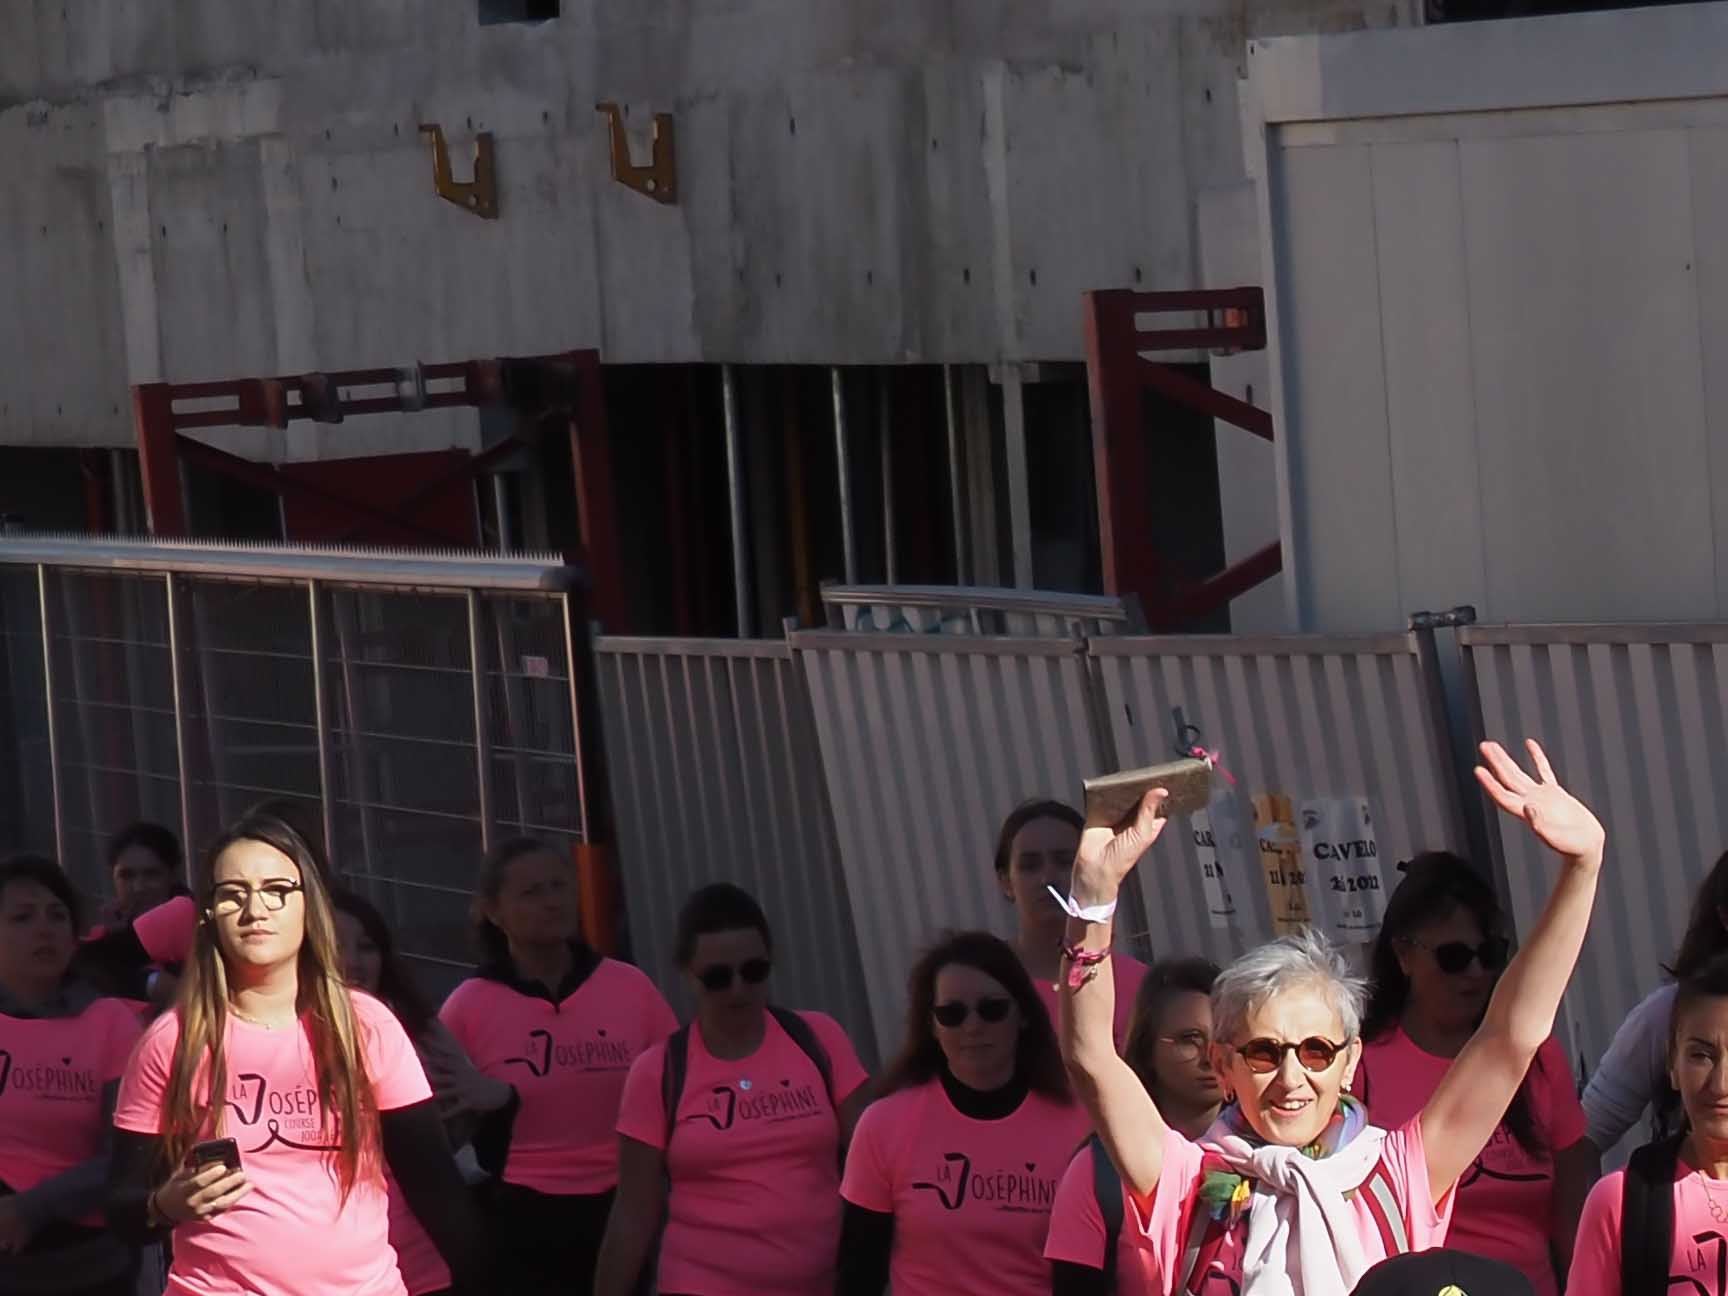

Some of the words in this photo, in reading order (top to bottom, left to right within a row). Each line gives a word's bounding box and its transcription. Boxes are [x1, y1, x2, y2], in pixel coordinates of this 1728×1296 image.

[231, 1083, 248, 1100] LA
[237, 1073, 318, 1126] JOSÉP
[936, 1164, 951, 1182] LA
[1687, 1247, 1707, 1273] LA
